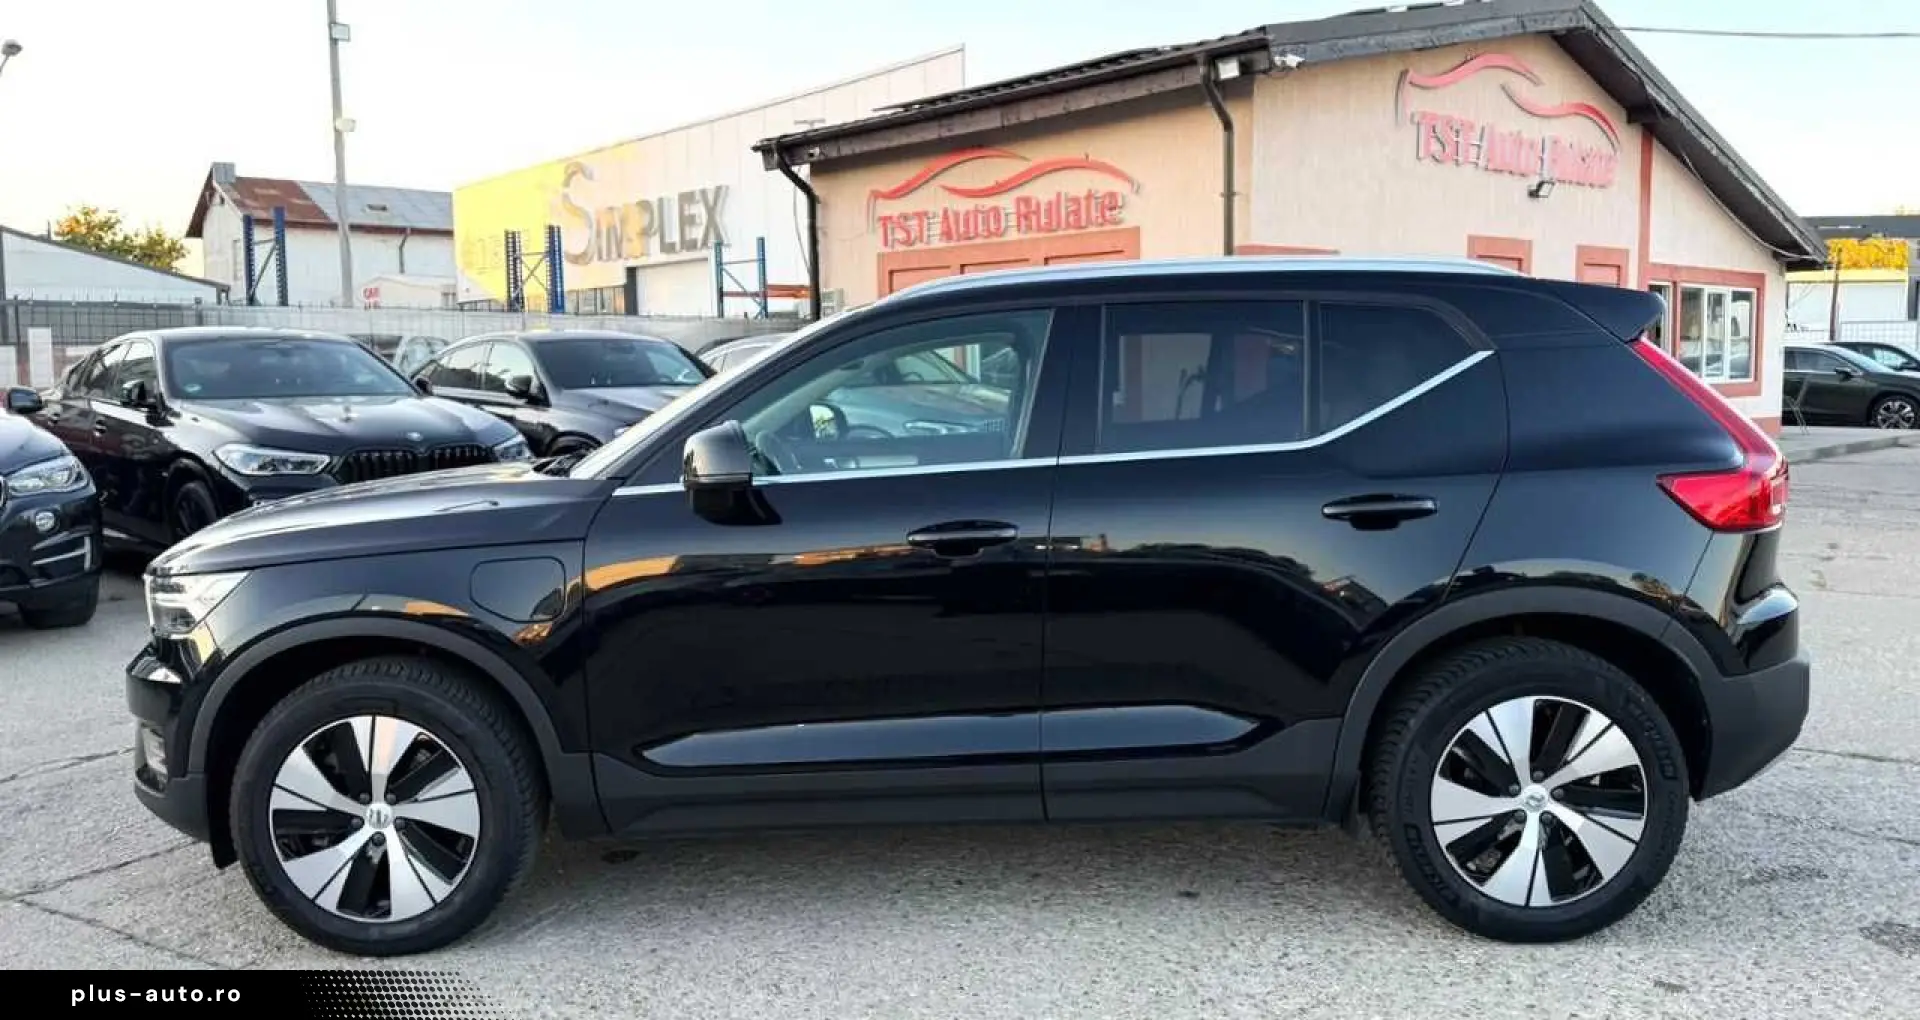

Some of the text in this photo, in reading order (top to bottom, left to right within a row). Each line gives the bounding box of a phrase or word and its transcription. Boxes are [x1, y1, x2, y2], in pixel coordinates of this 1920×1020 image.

[563, 161, 727, 266] SIMPLEX
[878, 190, 1123, 248] TST Auto Rulate
